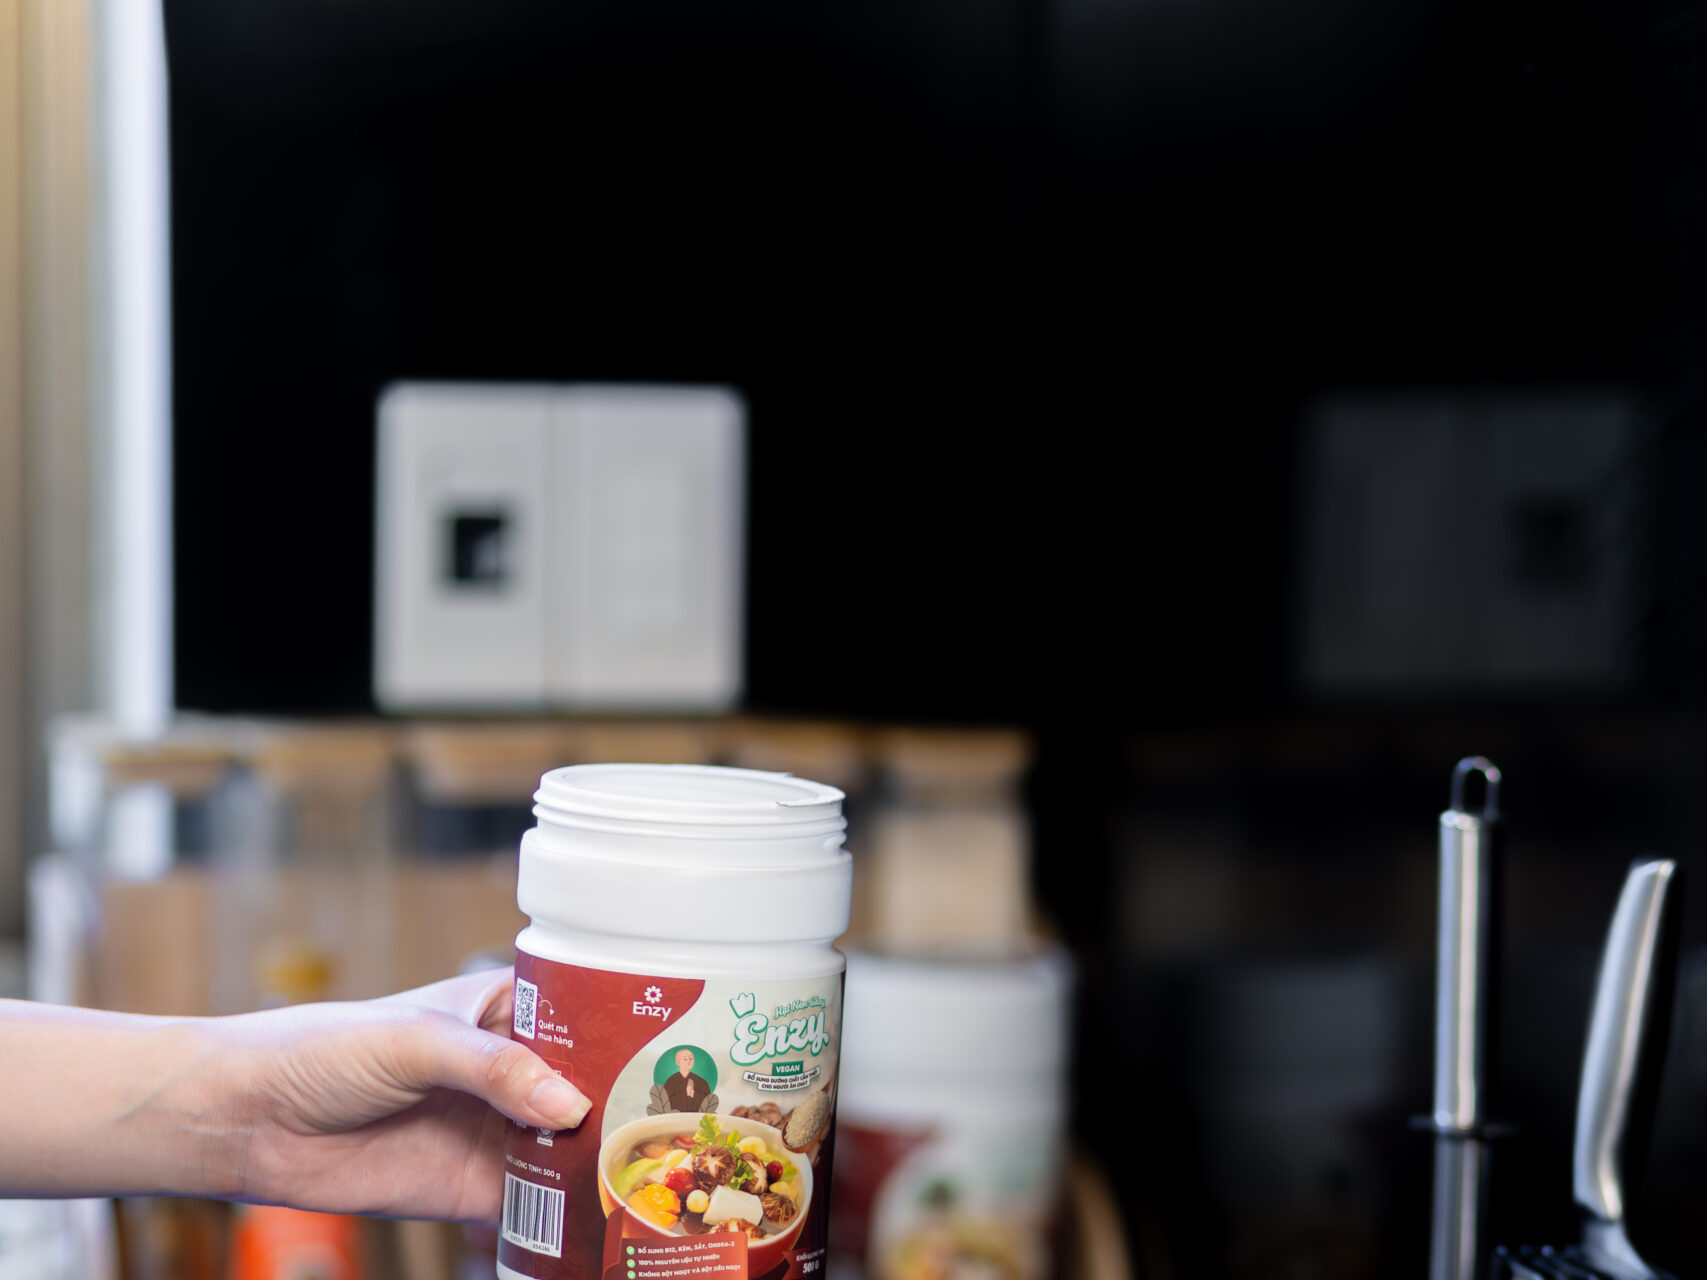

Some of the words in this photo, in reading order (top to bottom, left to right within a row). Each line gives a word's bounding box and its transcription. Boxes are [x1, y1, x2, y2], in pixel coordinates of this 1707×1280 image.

[632, 1001, 672, 1022] Enzy
[538, 1019, 554, 1031] Quét
[555, 1023, 568, 1034] mã
[537, 1032, 552, 1042] mua
[553, 1035, 573, 1048] hàng
[730, 1009, 830, 1067] Enzy
[775, 1064, 801, 1073] VEGAN
[543, 1168, 555, 1178] 500
[555, 1172, 561, 1181] g
[708, 1241, 735, 1249] OMEGA-3
